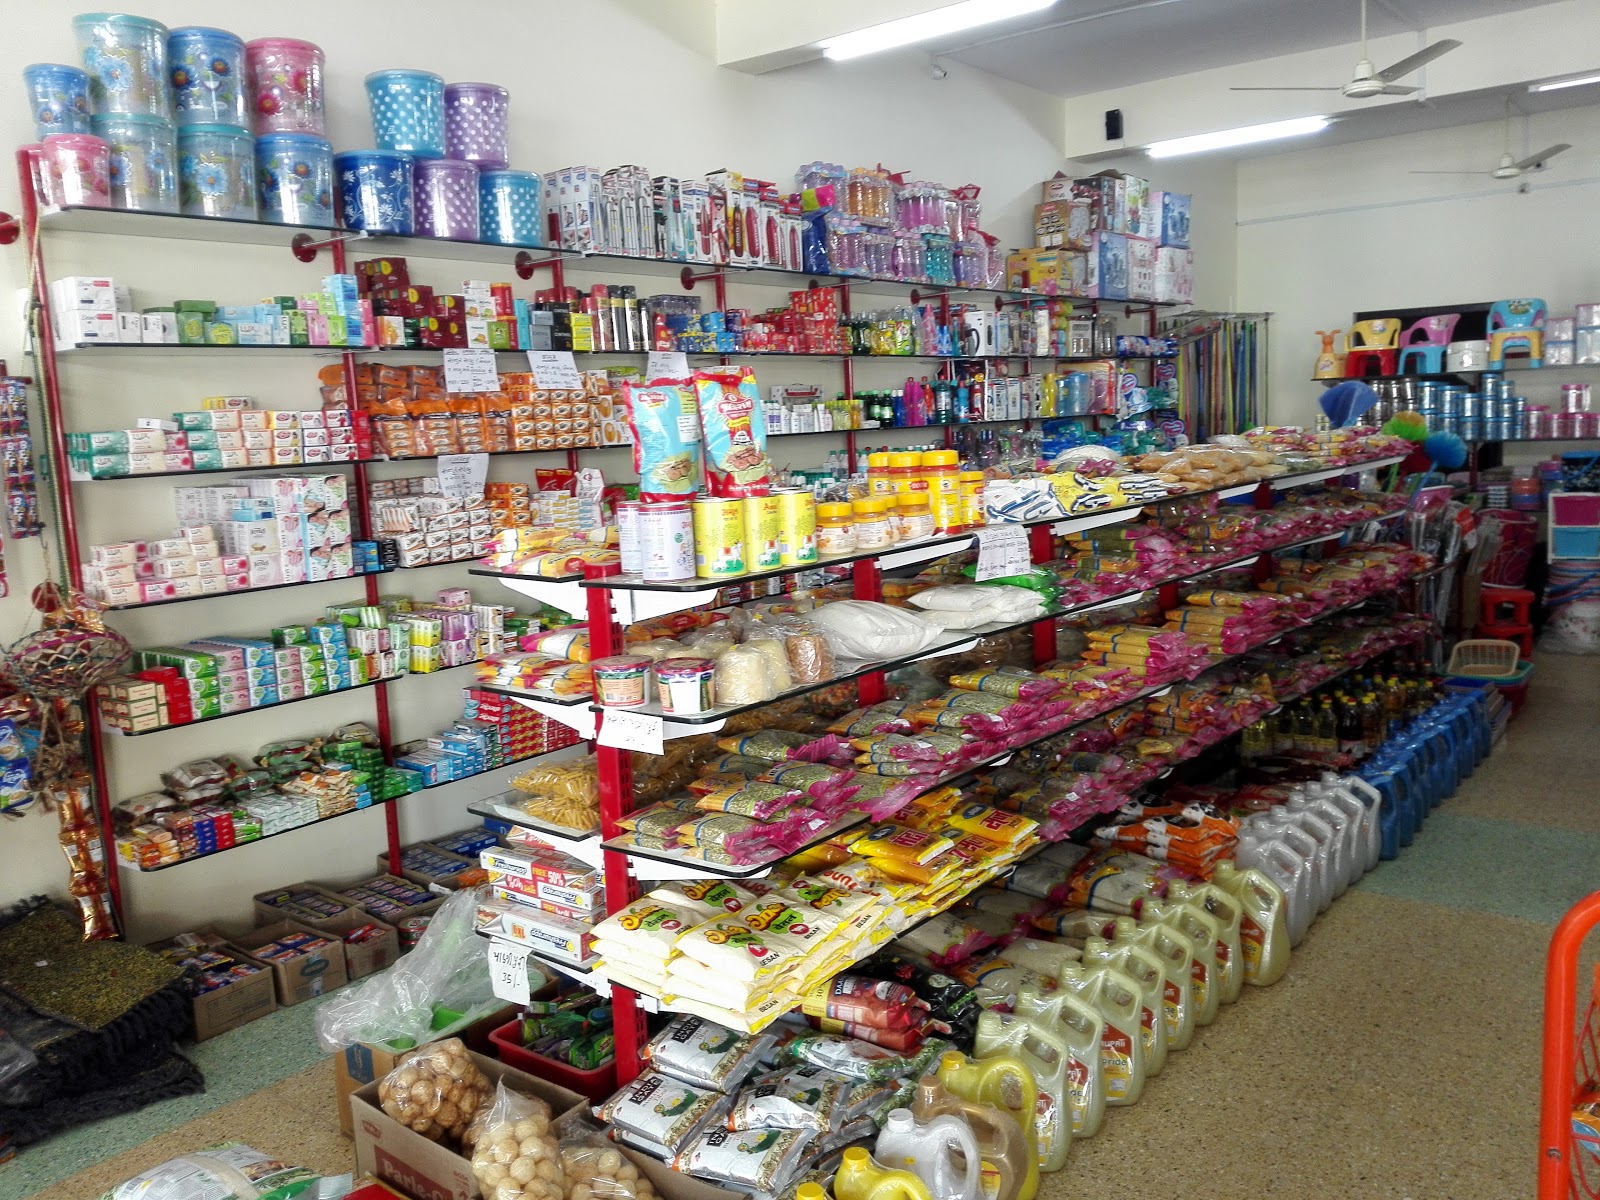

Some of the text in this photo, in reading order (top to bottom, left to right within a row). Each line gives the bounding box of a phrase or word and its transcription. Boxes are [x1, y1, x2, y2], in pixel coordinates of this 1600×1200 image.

[855, 914, 873, 929] BESAN
[758, 999, 779, 1013] BESAN
[632, 1077, 658, 1101] INDIA
[637, 1080, 662, 1102] GATE
